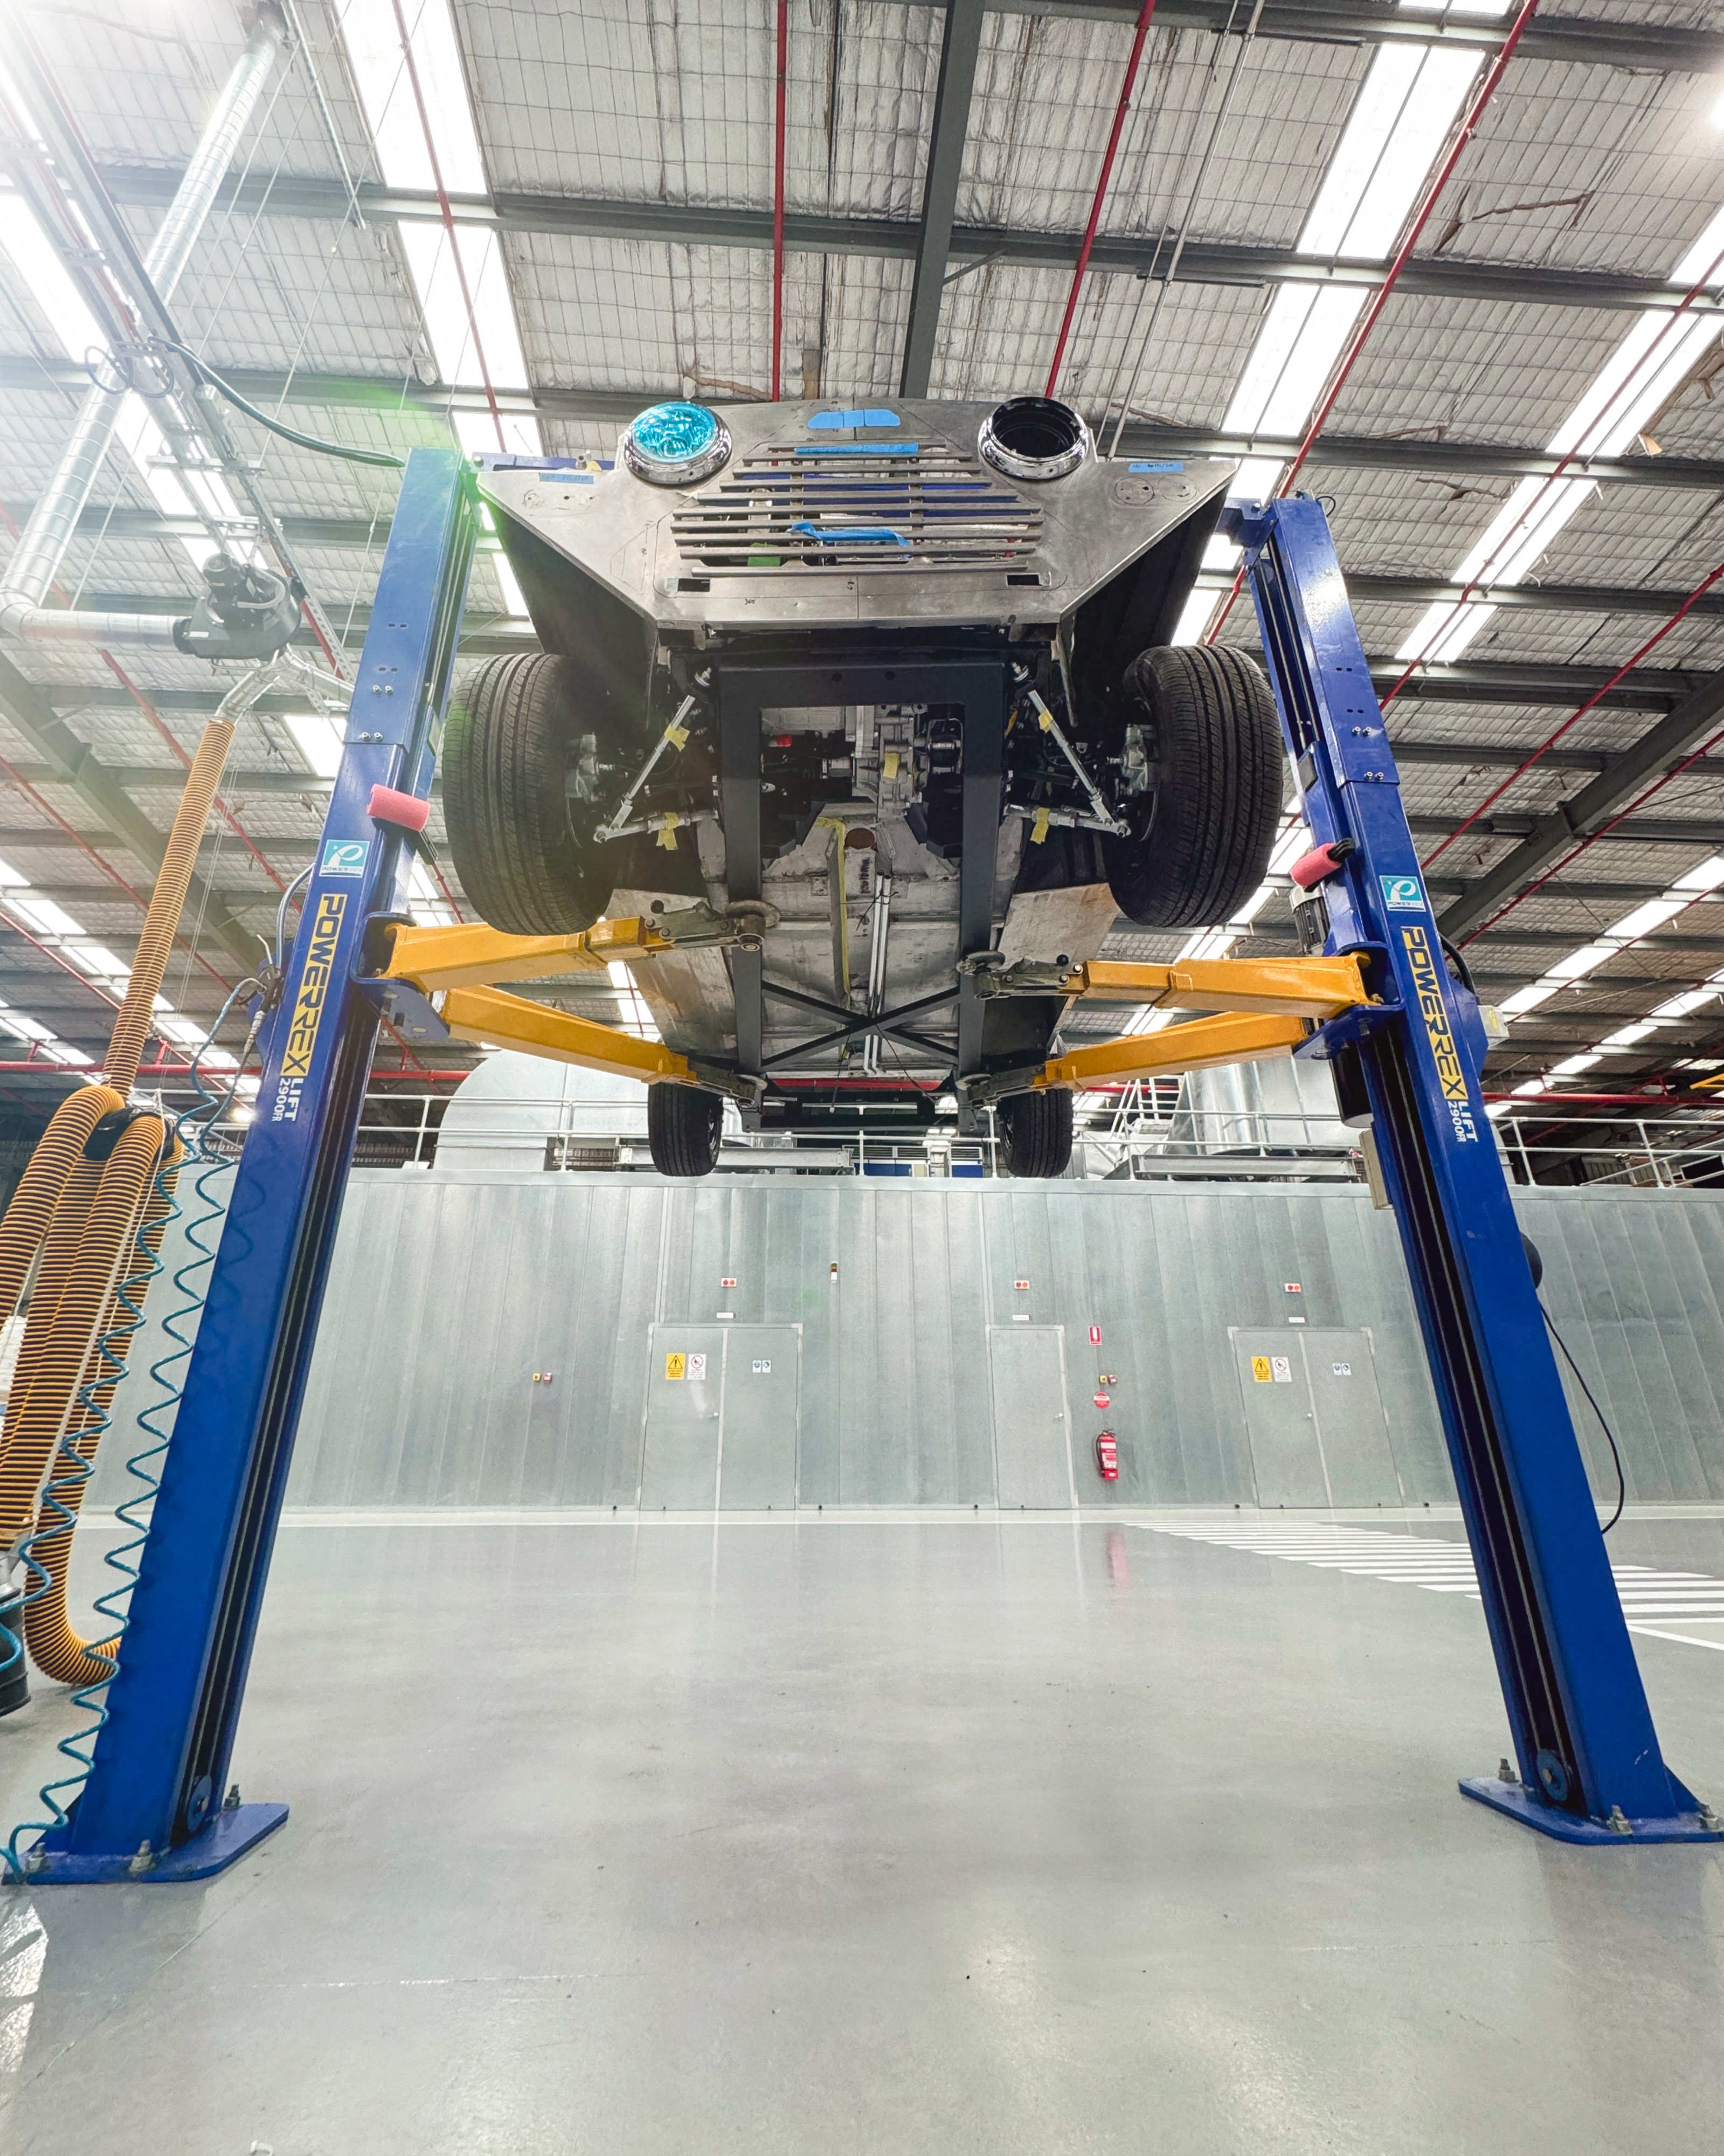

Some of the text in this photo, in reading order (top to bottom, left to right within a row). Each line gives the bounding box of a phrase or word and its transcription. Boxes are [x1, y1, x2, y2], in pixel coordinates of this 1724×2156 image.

[283, 895, 345, 1074] POWERREX
[1403, 928, 1466, 1097] POWERREX
[271, 1077, 291, 1122] 2900FR
[284, 1077, 304, 1122] LIFT
[1447, 1101, 1466, 1142] 2900FR
[1458, 1101, 1478, 1143] LIFT
